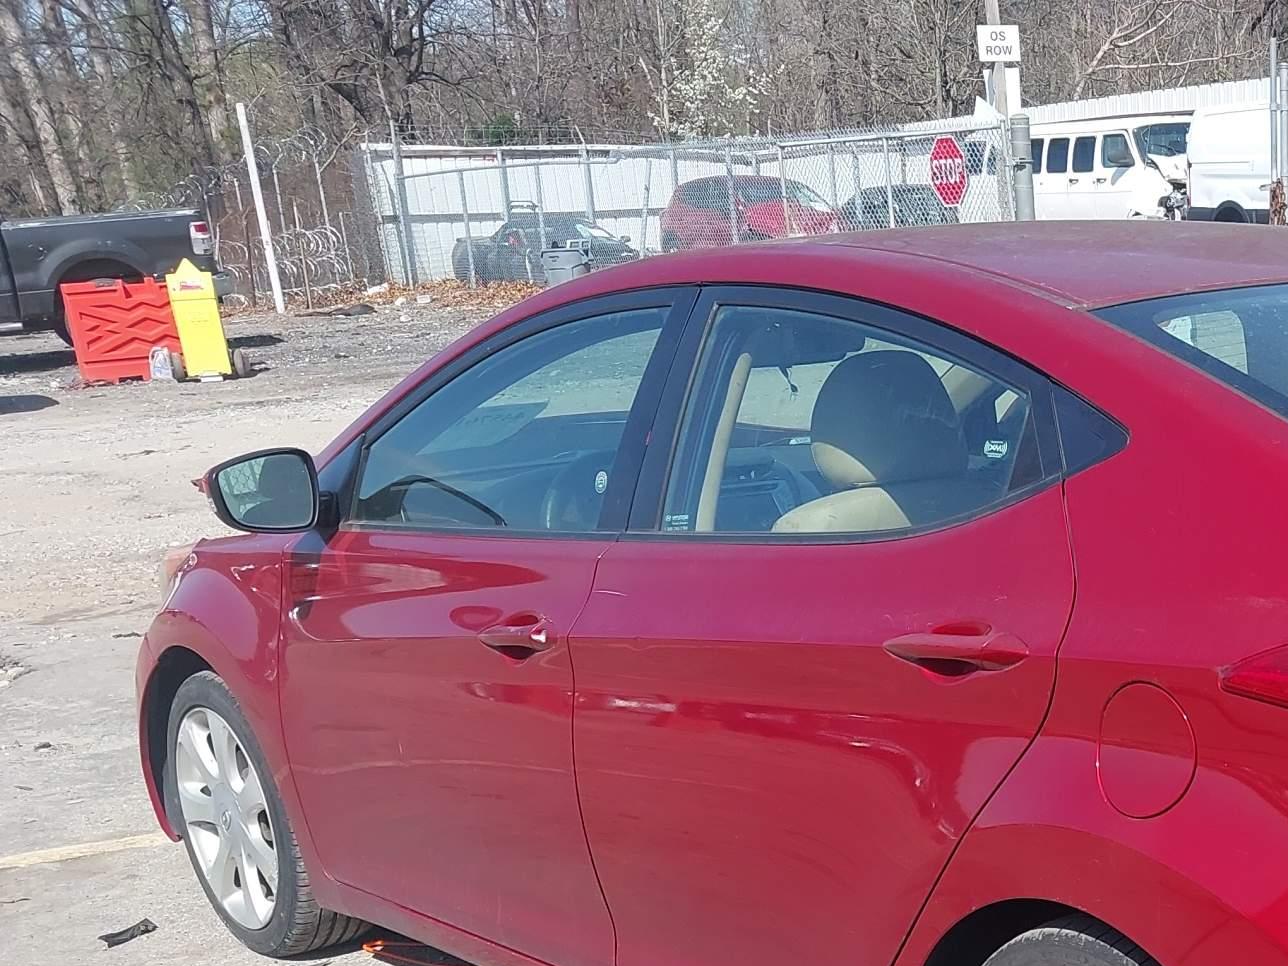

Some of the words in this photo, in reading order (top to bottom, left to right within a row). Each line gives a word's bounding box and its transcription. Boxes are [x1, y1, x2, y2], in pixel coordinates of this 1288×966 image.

[990, 31, 1006, 41] OS
[986, 45, 1012, 56] ROW
[932, 159, 962, 185] STOP
